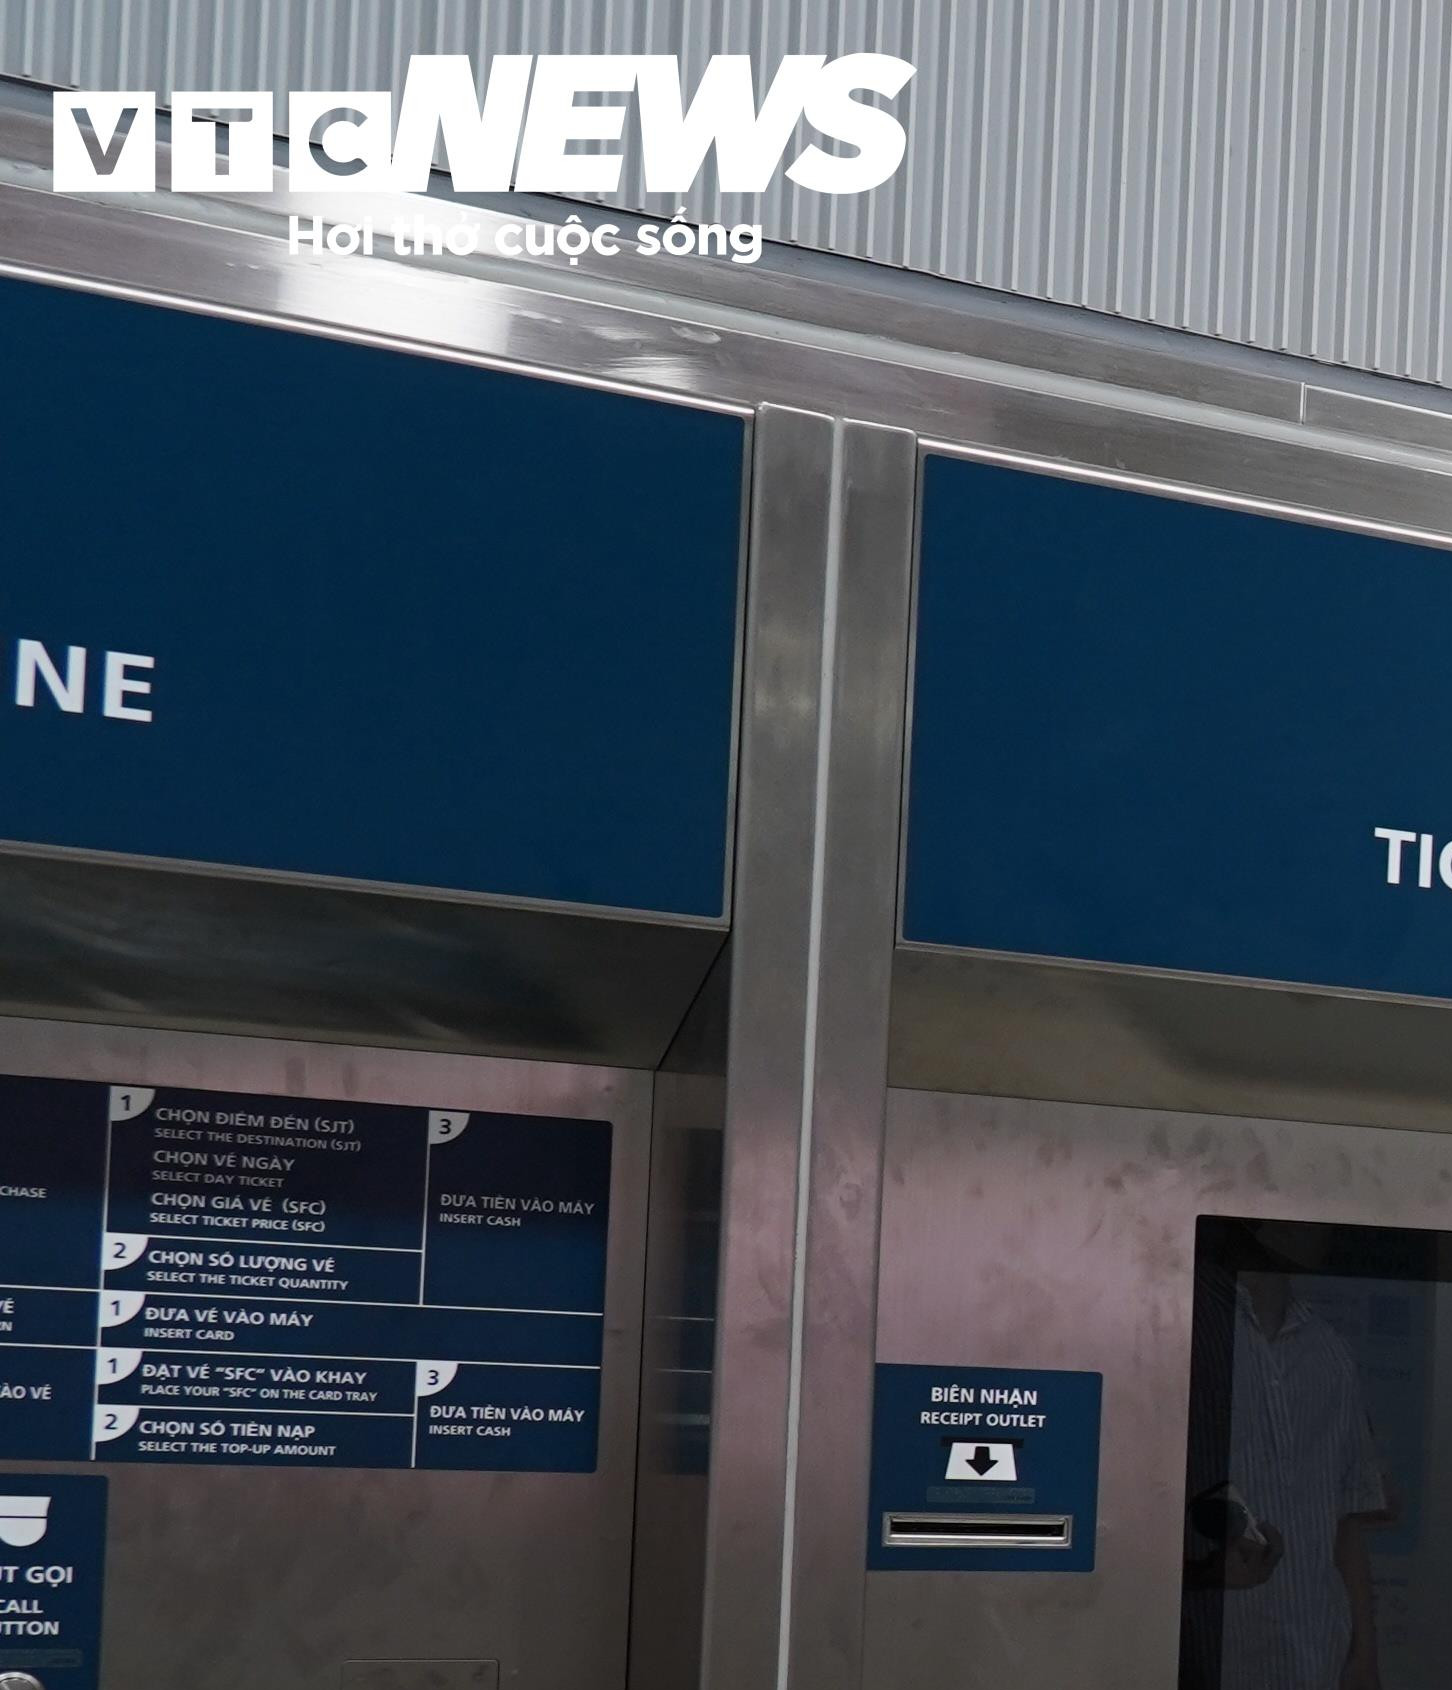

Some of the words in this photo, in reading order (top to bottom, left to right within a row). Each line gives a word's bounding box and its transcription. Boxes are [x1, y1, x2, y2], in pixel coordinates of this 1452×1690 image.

[931, 1384, 974, 1403] BIÊN
[920, 1411, 983, 1426] RECEIPT
[986, 1413, 1046, 1428] OUTLET
[25, 1566, 73, 1588] GỌI
